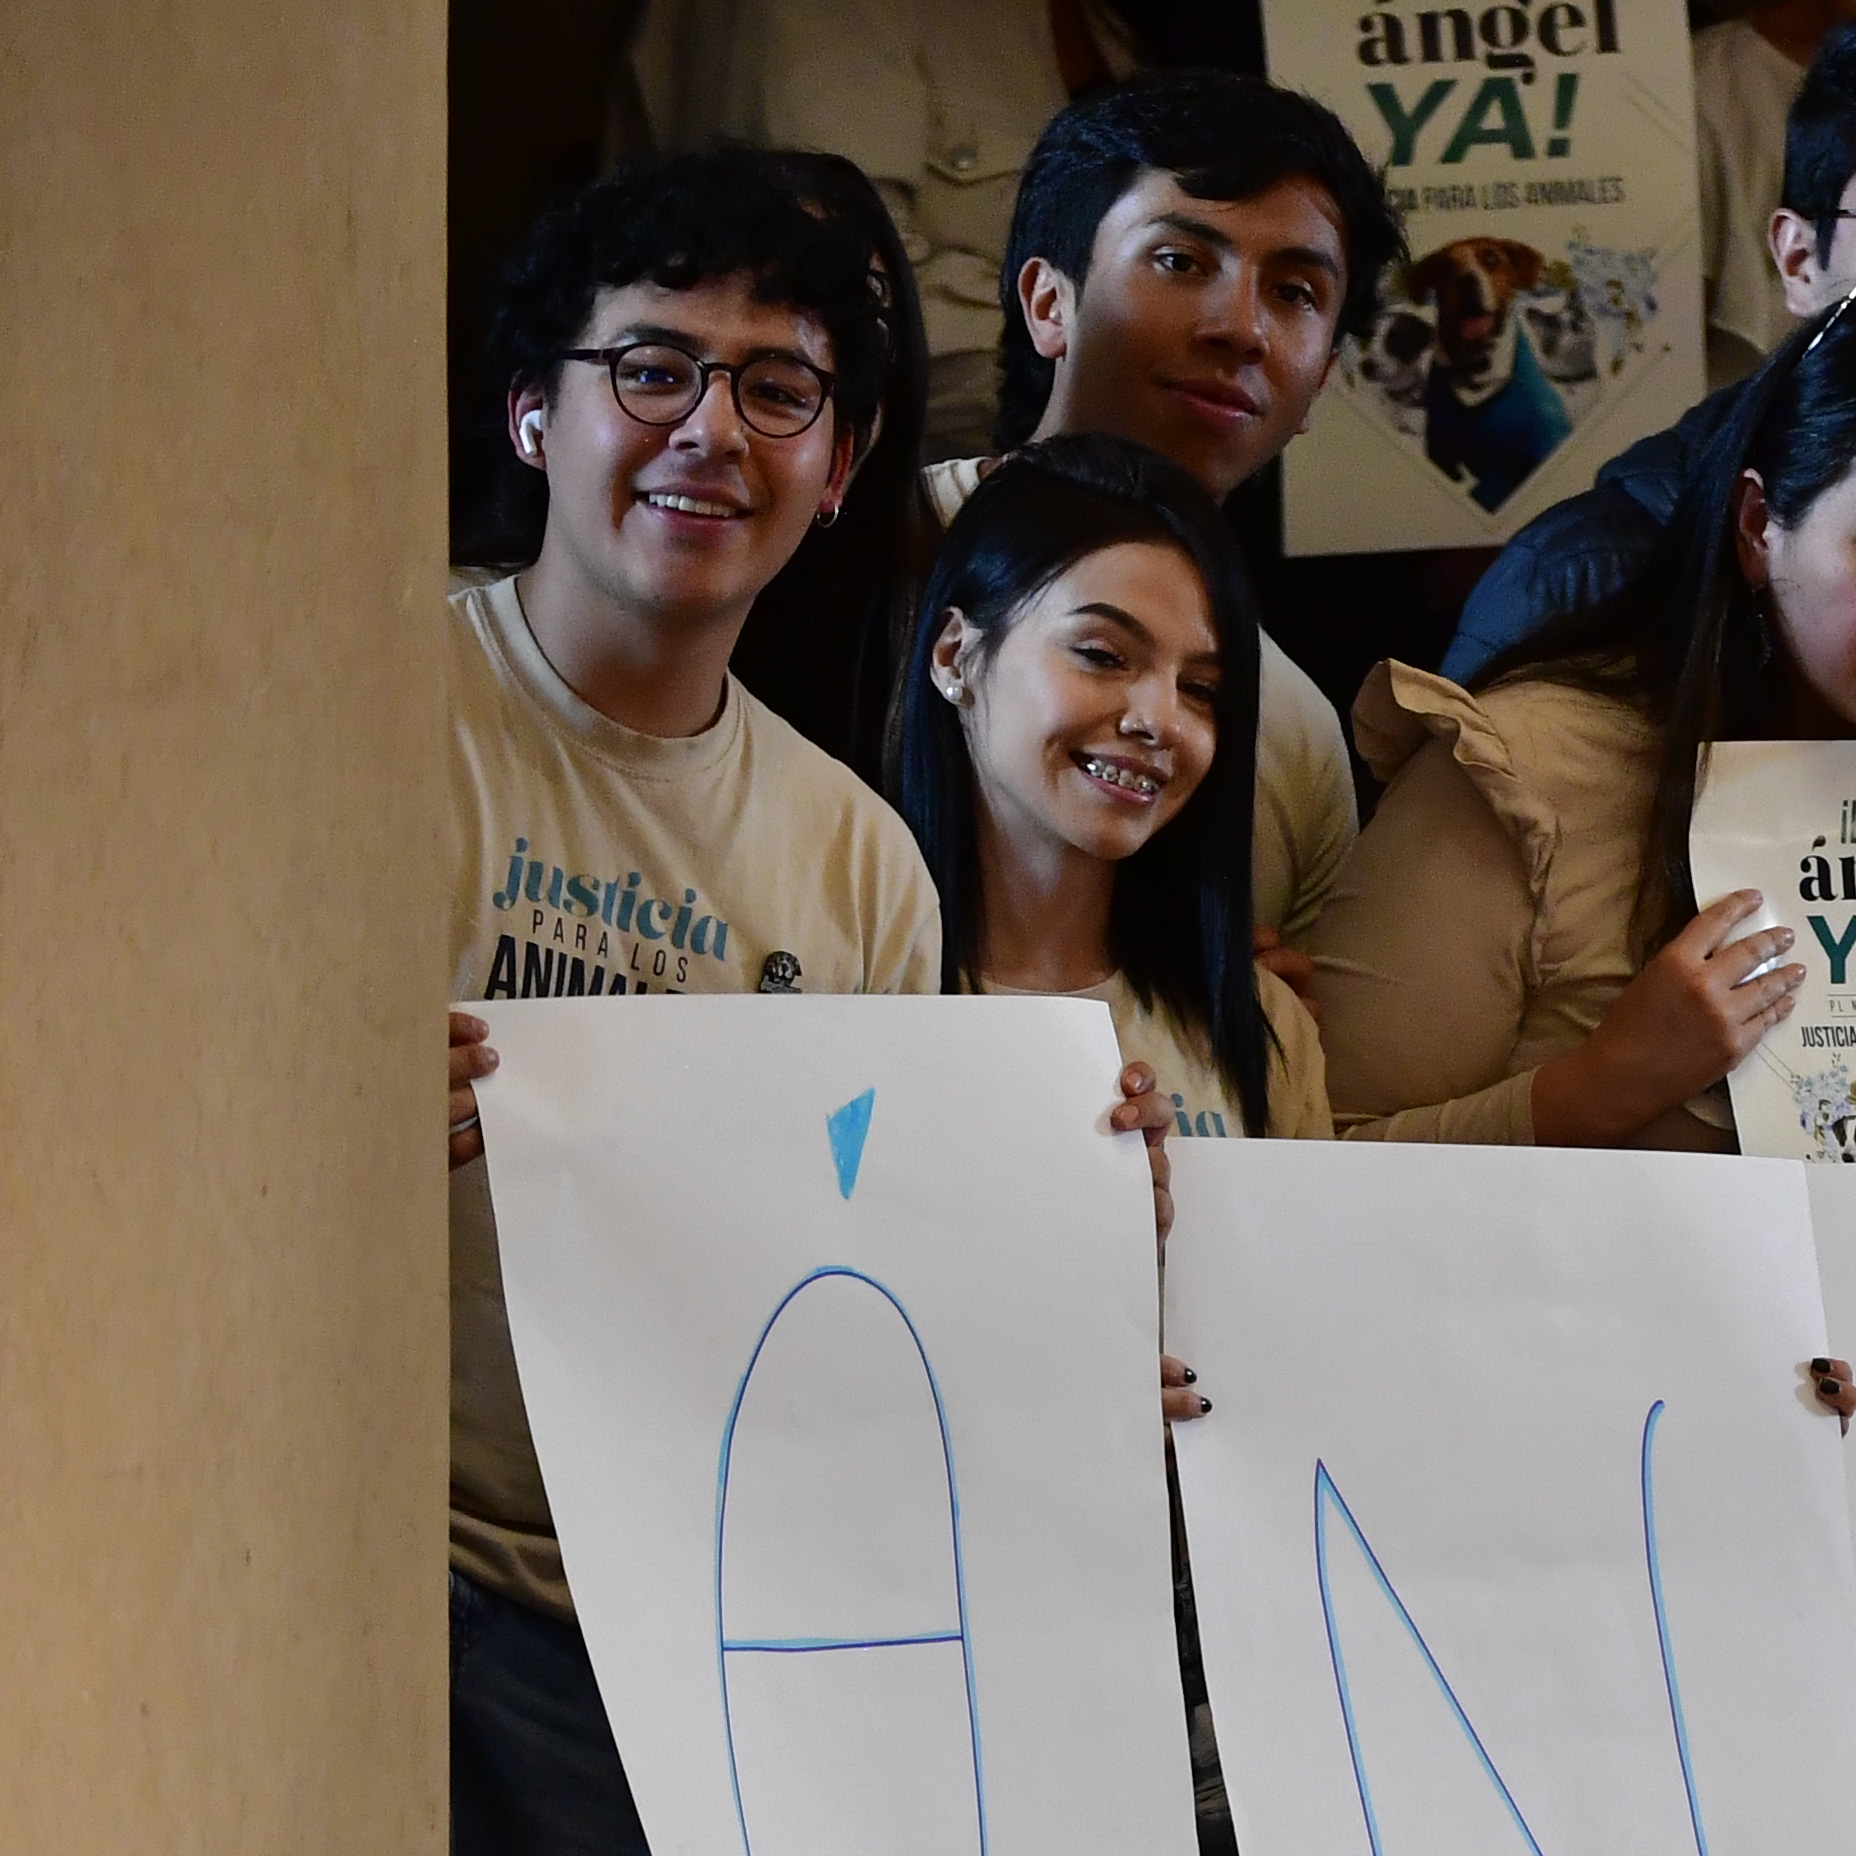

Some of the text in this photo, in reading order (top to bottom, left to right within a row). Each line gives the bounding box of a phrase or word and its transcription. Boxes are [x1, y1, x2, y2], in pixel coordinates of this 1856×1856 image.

[1357, 0, 1621, 85] ángel
[1366, 72, 1580, 167] YA!
[493, 837, 728, 961] justicia
[483, 933, 687, 1000] ANIM
[532, 909, 689, 984] PARA LOS
